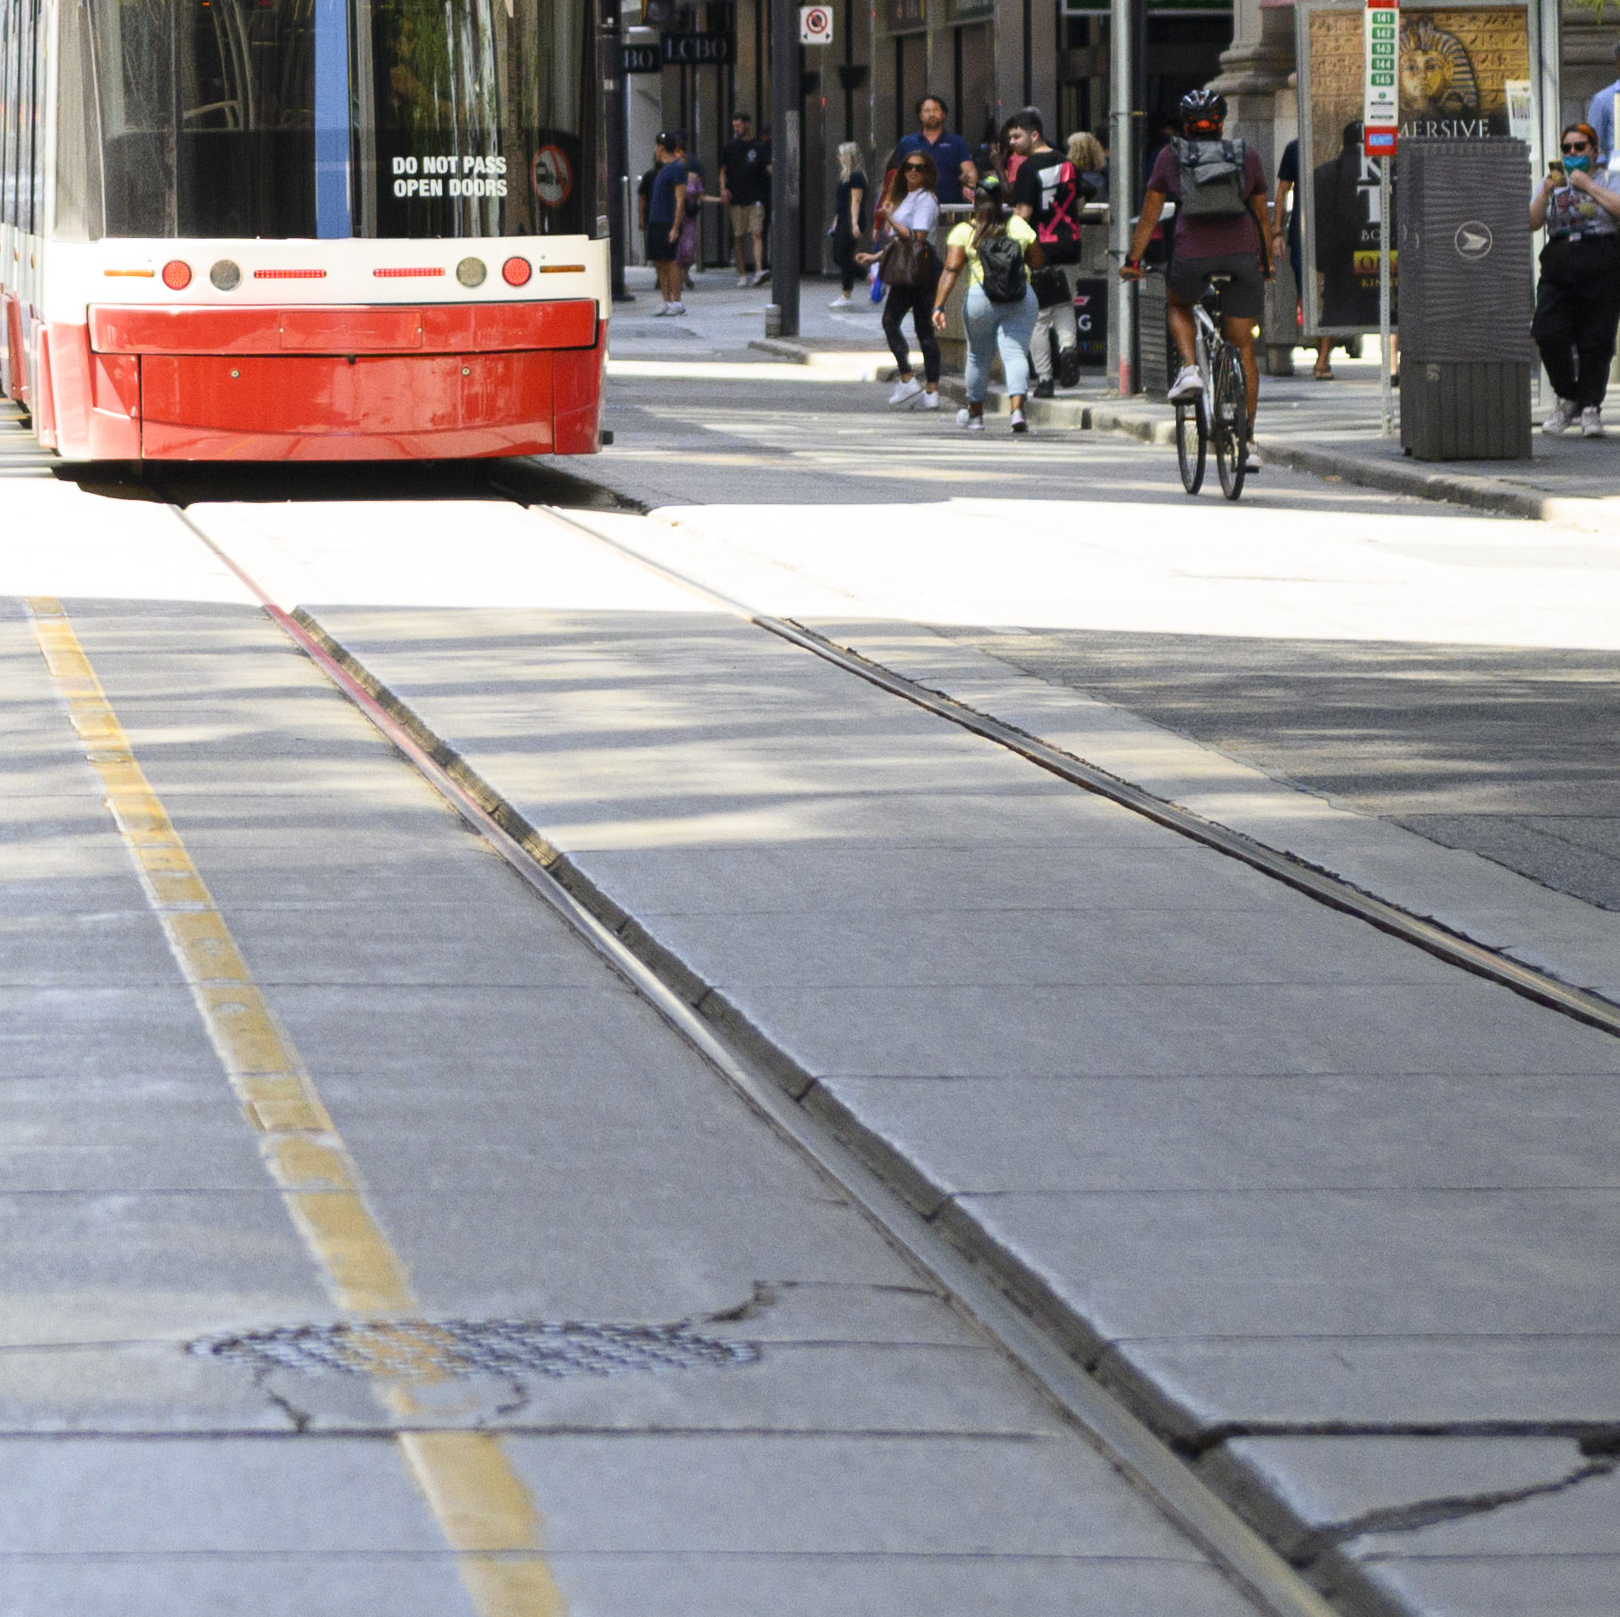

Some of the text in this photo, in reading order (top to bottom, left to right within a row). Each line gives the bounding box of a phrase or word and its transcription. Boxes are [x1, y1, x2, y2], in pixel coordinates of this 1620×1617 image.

[666, 38, 727, 60] LCBO
[392, 155, 508, 175] DO NOT PASS
[394, 178, 508, 197] OPEN DOORS
